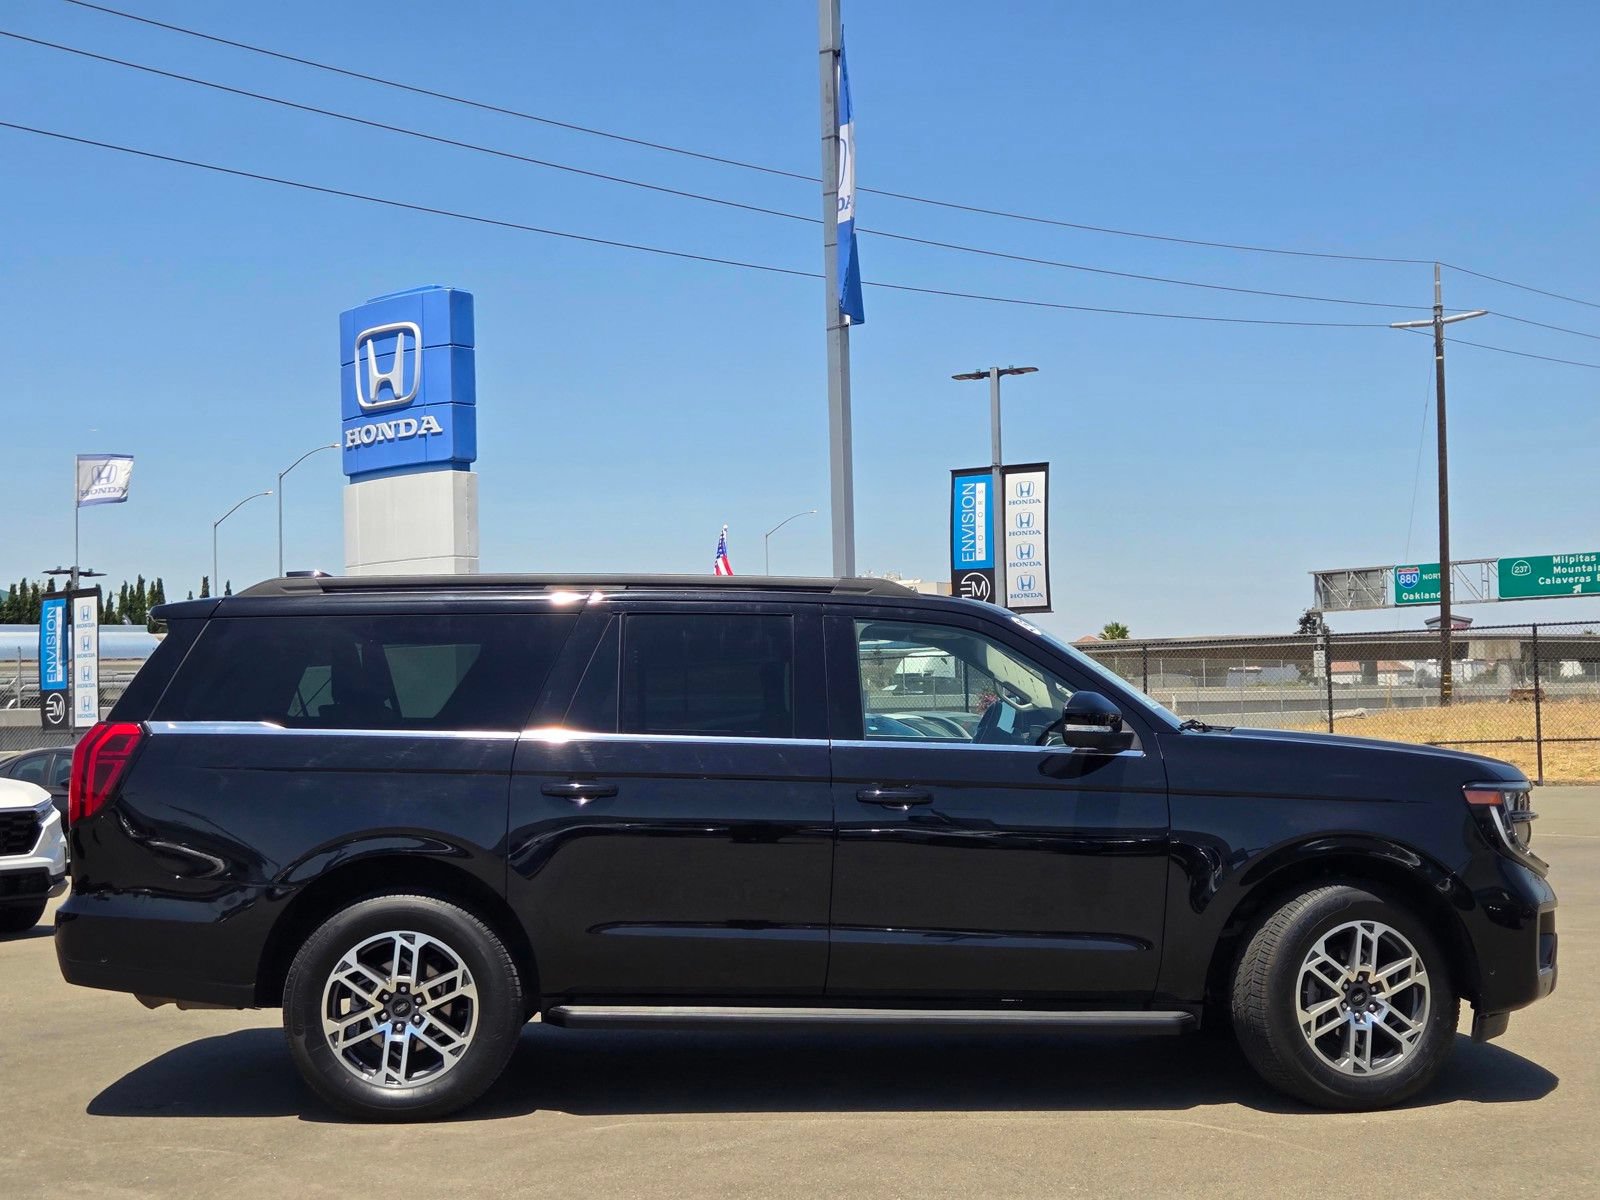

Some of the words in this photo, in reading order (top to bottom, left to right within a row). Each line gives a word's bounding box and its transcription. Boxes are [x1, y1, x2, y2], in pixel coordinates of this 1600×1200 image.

[345, 417, 443, 448] HONDA
[79, 486, 126, 497] HONDA
[1008, 498, 1042, 506] HONDA
[961, 482, 976, 562] ENVISION
[1008, 529, 1042, 537] HONDA
[1008, 560, 1043, 568] HONDA
[1552, 555, 1597, 564] Milpitas
[1514, 565, 1528, 574] 237
[1399, 573, 1418, 584] 880
[1538, 575, 1591, 585] Calaveras
[46, 606, 57, 683] ENVISION
